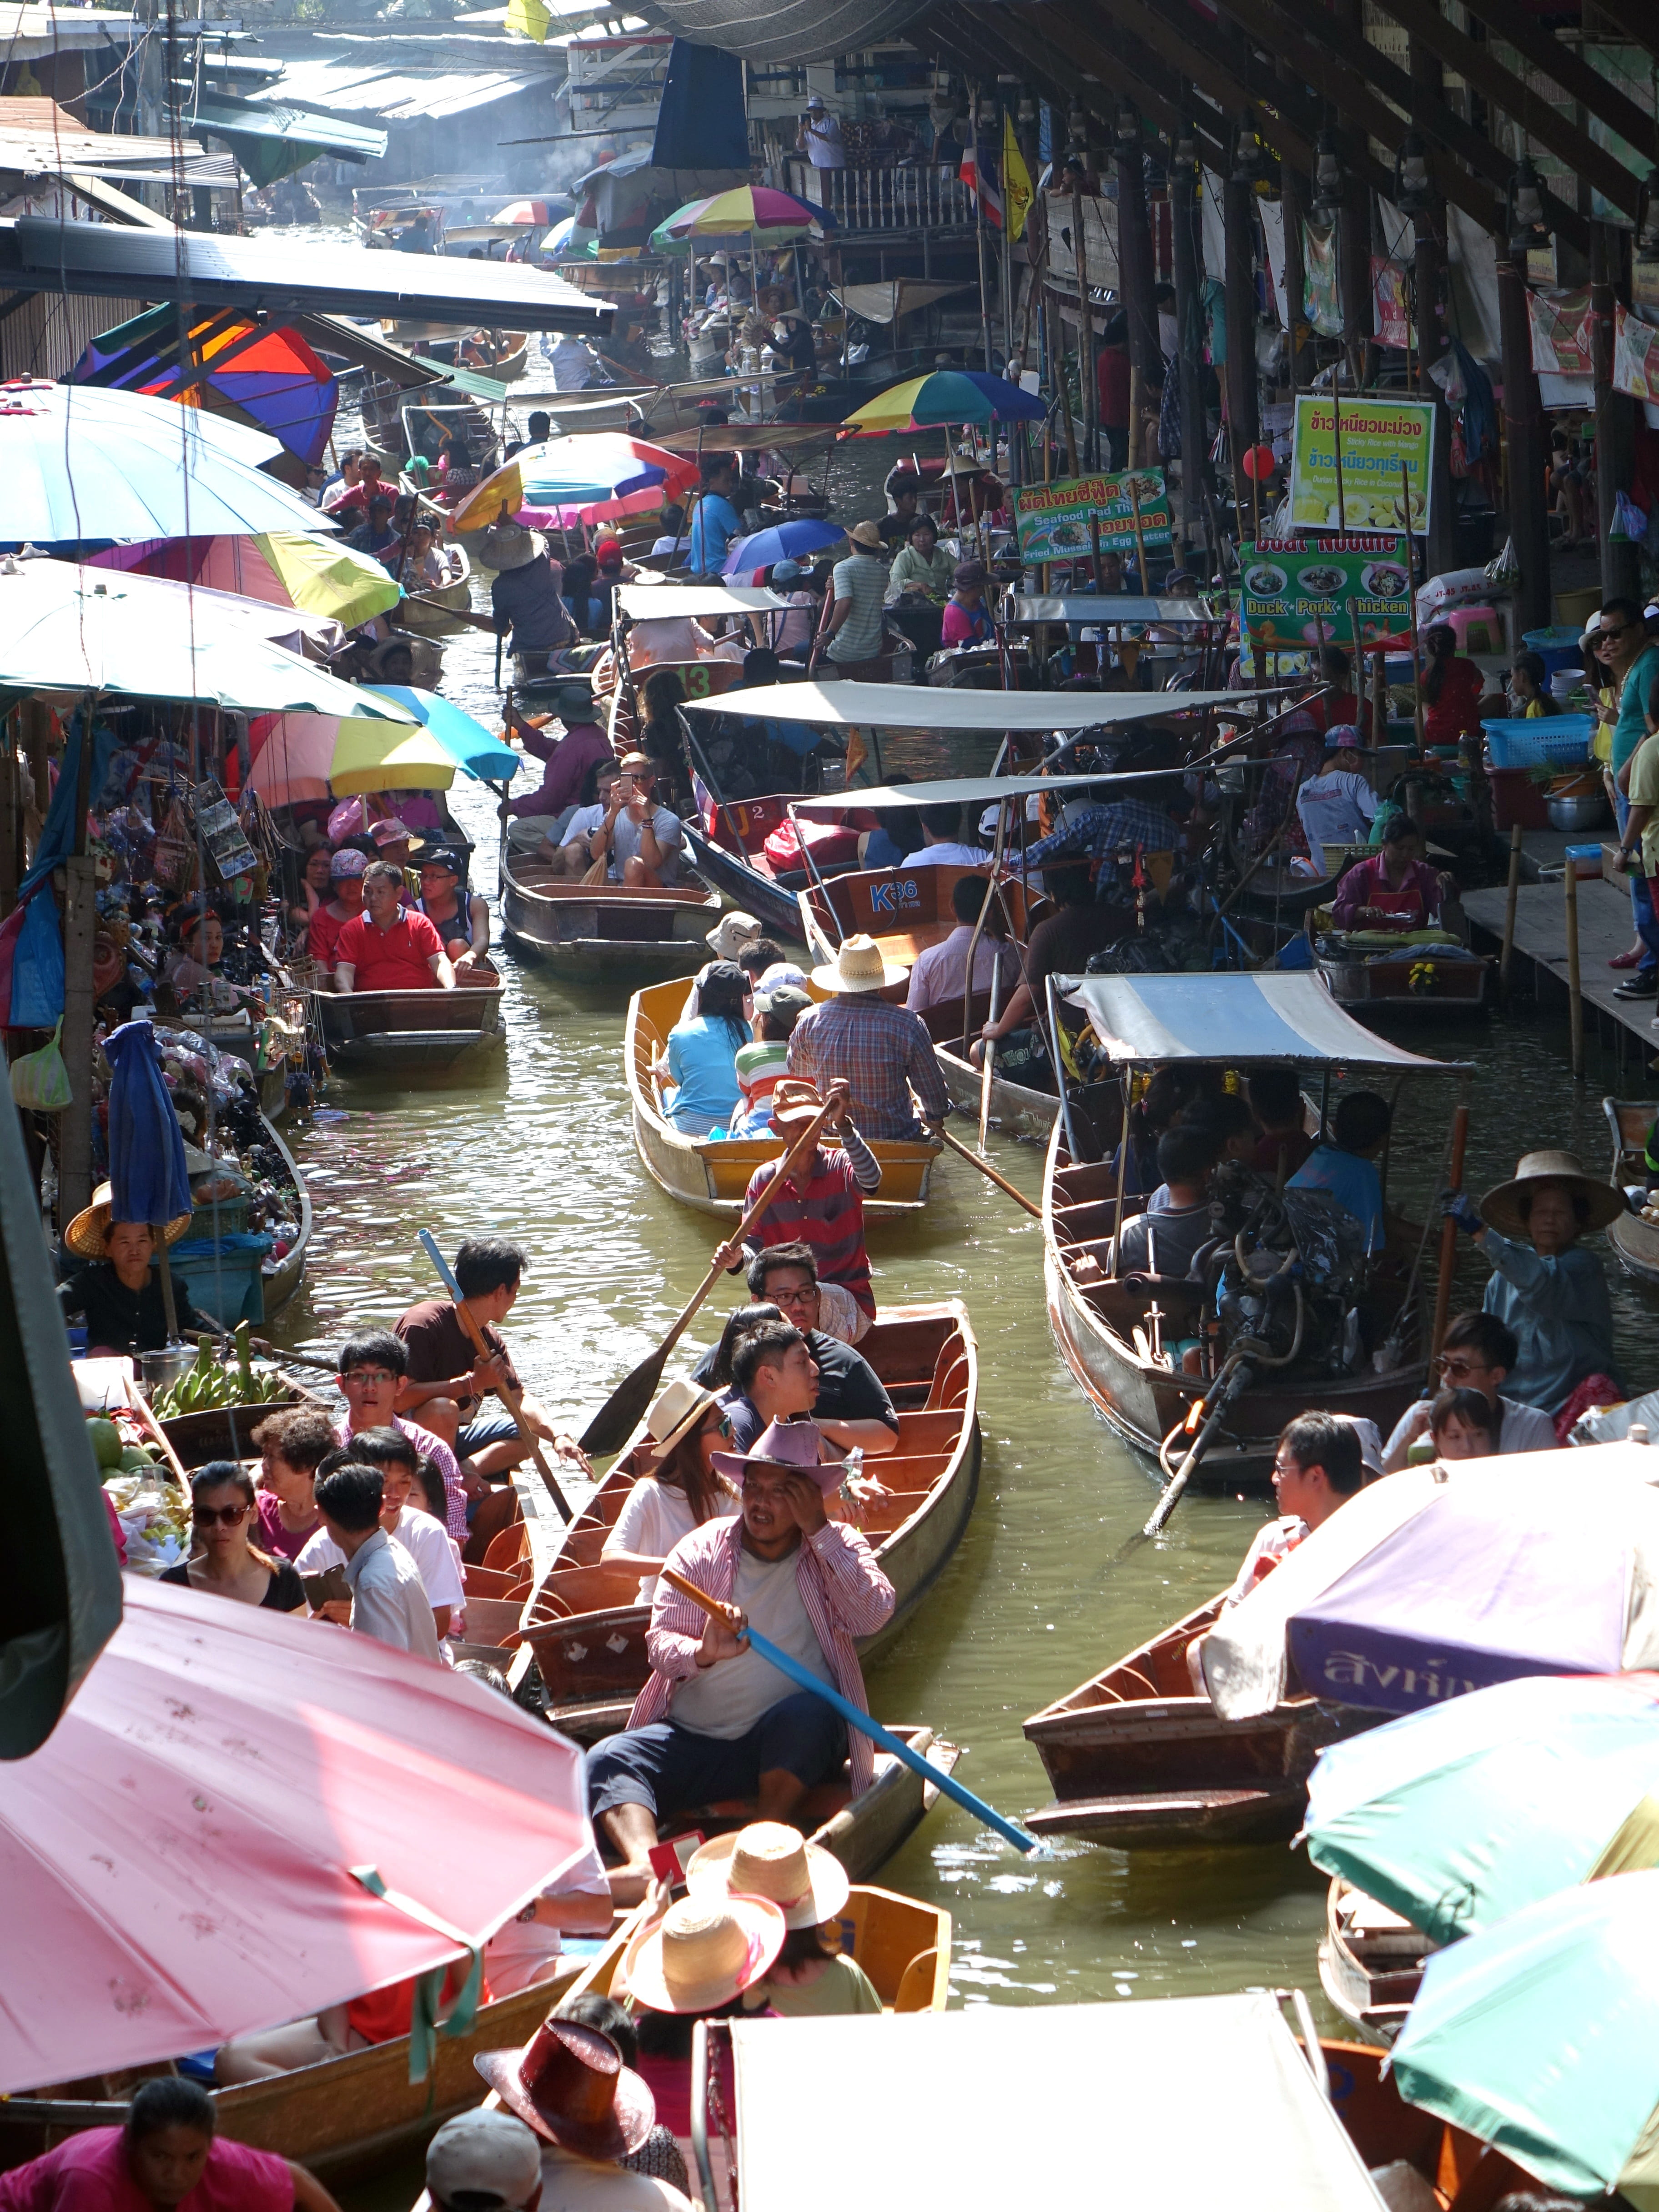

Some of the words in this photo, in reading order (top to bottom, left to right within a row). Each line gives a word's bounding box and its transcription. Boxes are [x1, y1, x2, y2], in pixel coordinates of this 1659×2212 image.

[1311, 411, 1422, 435] ข้าวหนียวมะม่วง
[1347, 437, 1365, 447] Sticky
[1367, 438, 1381, 447] Rice
[1383, 440, 1396, 448] with
[1398, 440, 1419, 450] Mango
[1334, 476, 1352, 486] Scky
[1354, 478, 1368, 486] Rice
[1034, 510, 1083, 526] Seafood
[1024, 550, 1050, 559] Fried
[1053, 541, 1093, 554] Mussel
[1112, 537, 1131, 547] Egg
[1135, 532, 1170, 542] atter
[1247, 598, 1288, 615] Duck
[1297, 598, 1337, 615] Pork
[1346, 598, 1408, 615] hicken
[870, 880, 917, 912] K36
